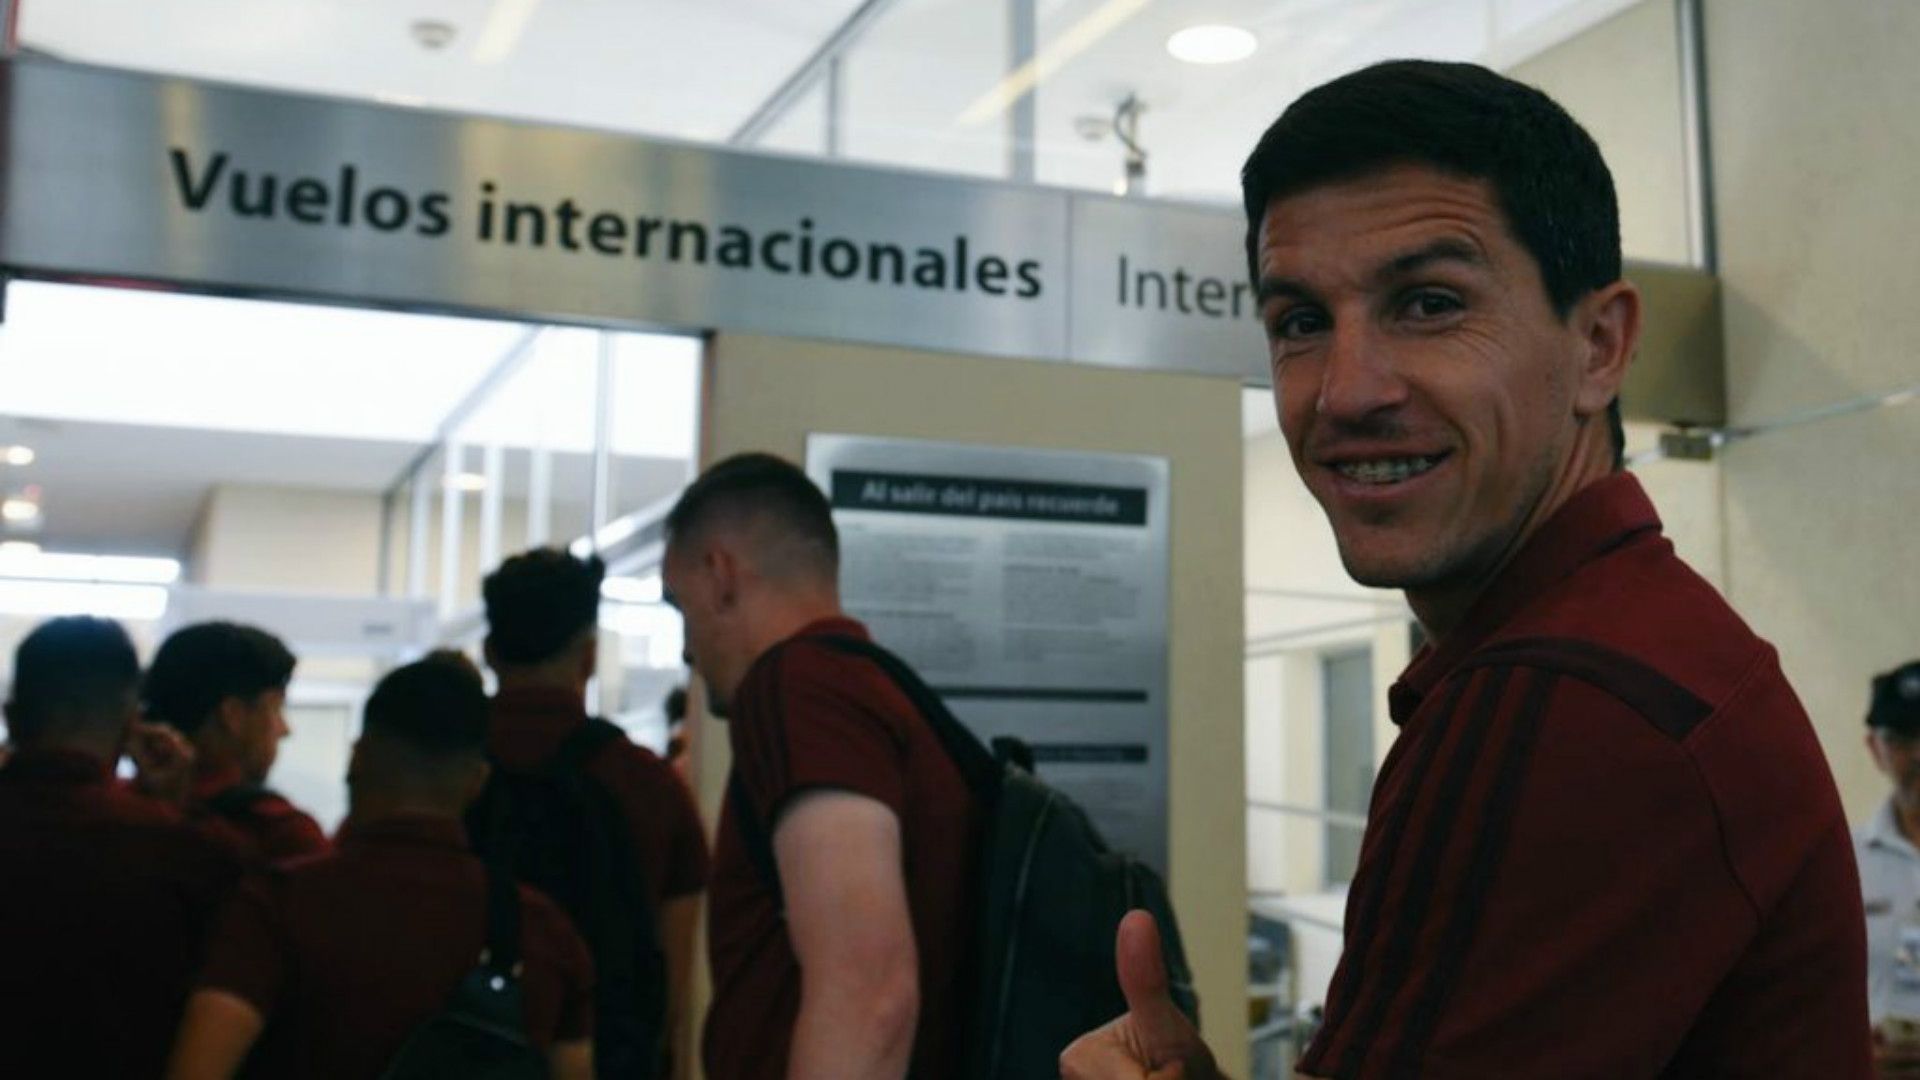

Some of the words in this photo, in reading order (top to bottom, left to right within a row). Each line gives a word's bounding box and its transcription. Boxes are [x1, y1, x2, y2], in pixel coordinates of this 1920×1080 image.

[170, 148, 451, 237] Vuelos
[476, 181, 1042, 299] internacionales
[890, 483, 935, 505] salir
[939, 485, 976, 507] del
